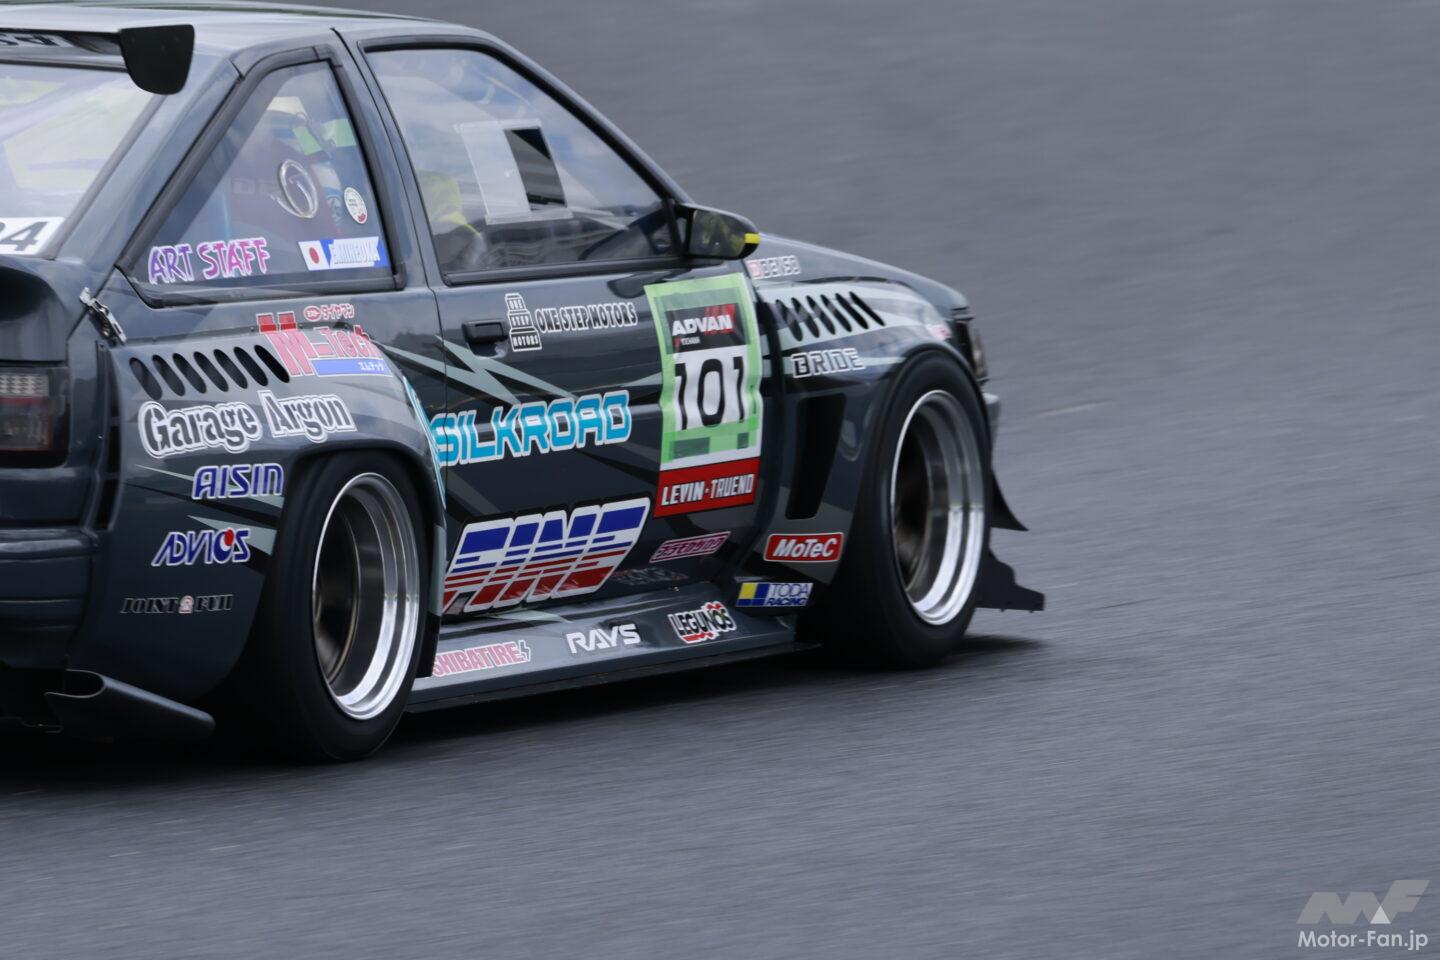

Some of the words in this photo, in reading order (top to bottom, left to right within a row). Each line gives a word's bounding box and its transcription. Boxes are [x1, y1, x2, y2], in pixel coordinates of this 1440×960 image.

[148, 244, 196, 285] ART
[196, 237, 271, 279] STAFF
[535, 307, 562, 333] ONE
[560, 304, 592, 331] STEP
[589, 302, 639, 329] MOTORS
[671, 314, 734, 337] ADVAN
[791, 347, 867, 379] BRIDE
[674, 356, 746, 431] 101
[138, 400, 264, 459] Garage
[257, 389, 358, 443] Argon
[430, 389, 633, 467] SILKROAD
[191, 462, 285, 500] AISIN
[151, 526, 252, 568] ADVICS
[772, 536, 838, 559] MoTeC
[770, 583, 810, 598] TODA
[566, 622, 641, 655] RAYS
